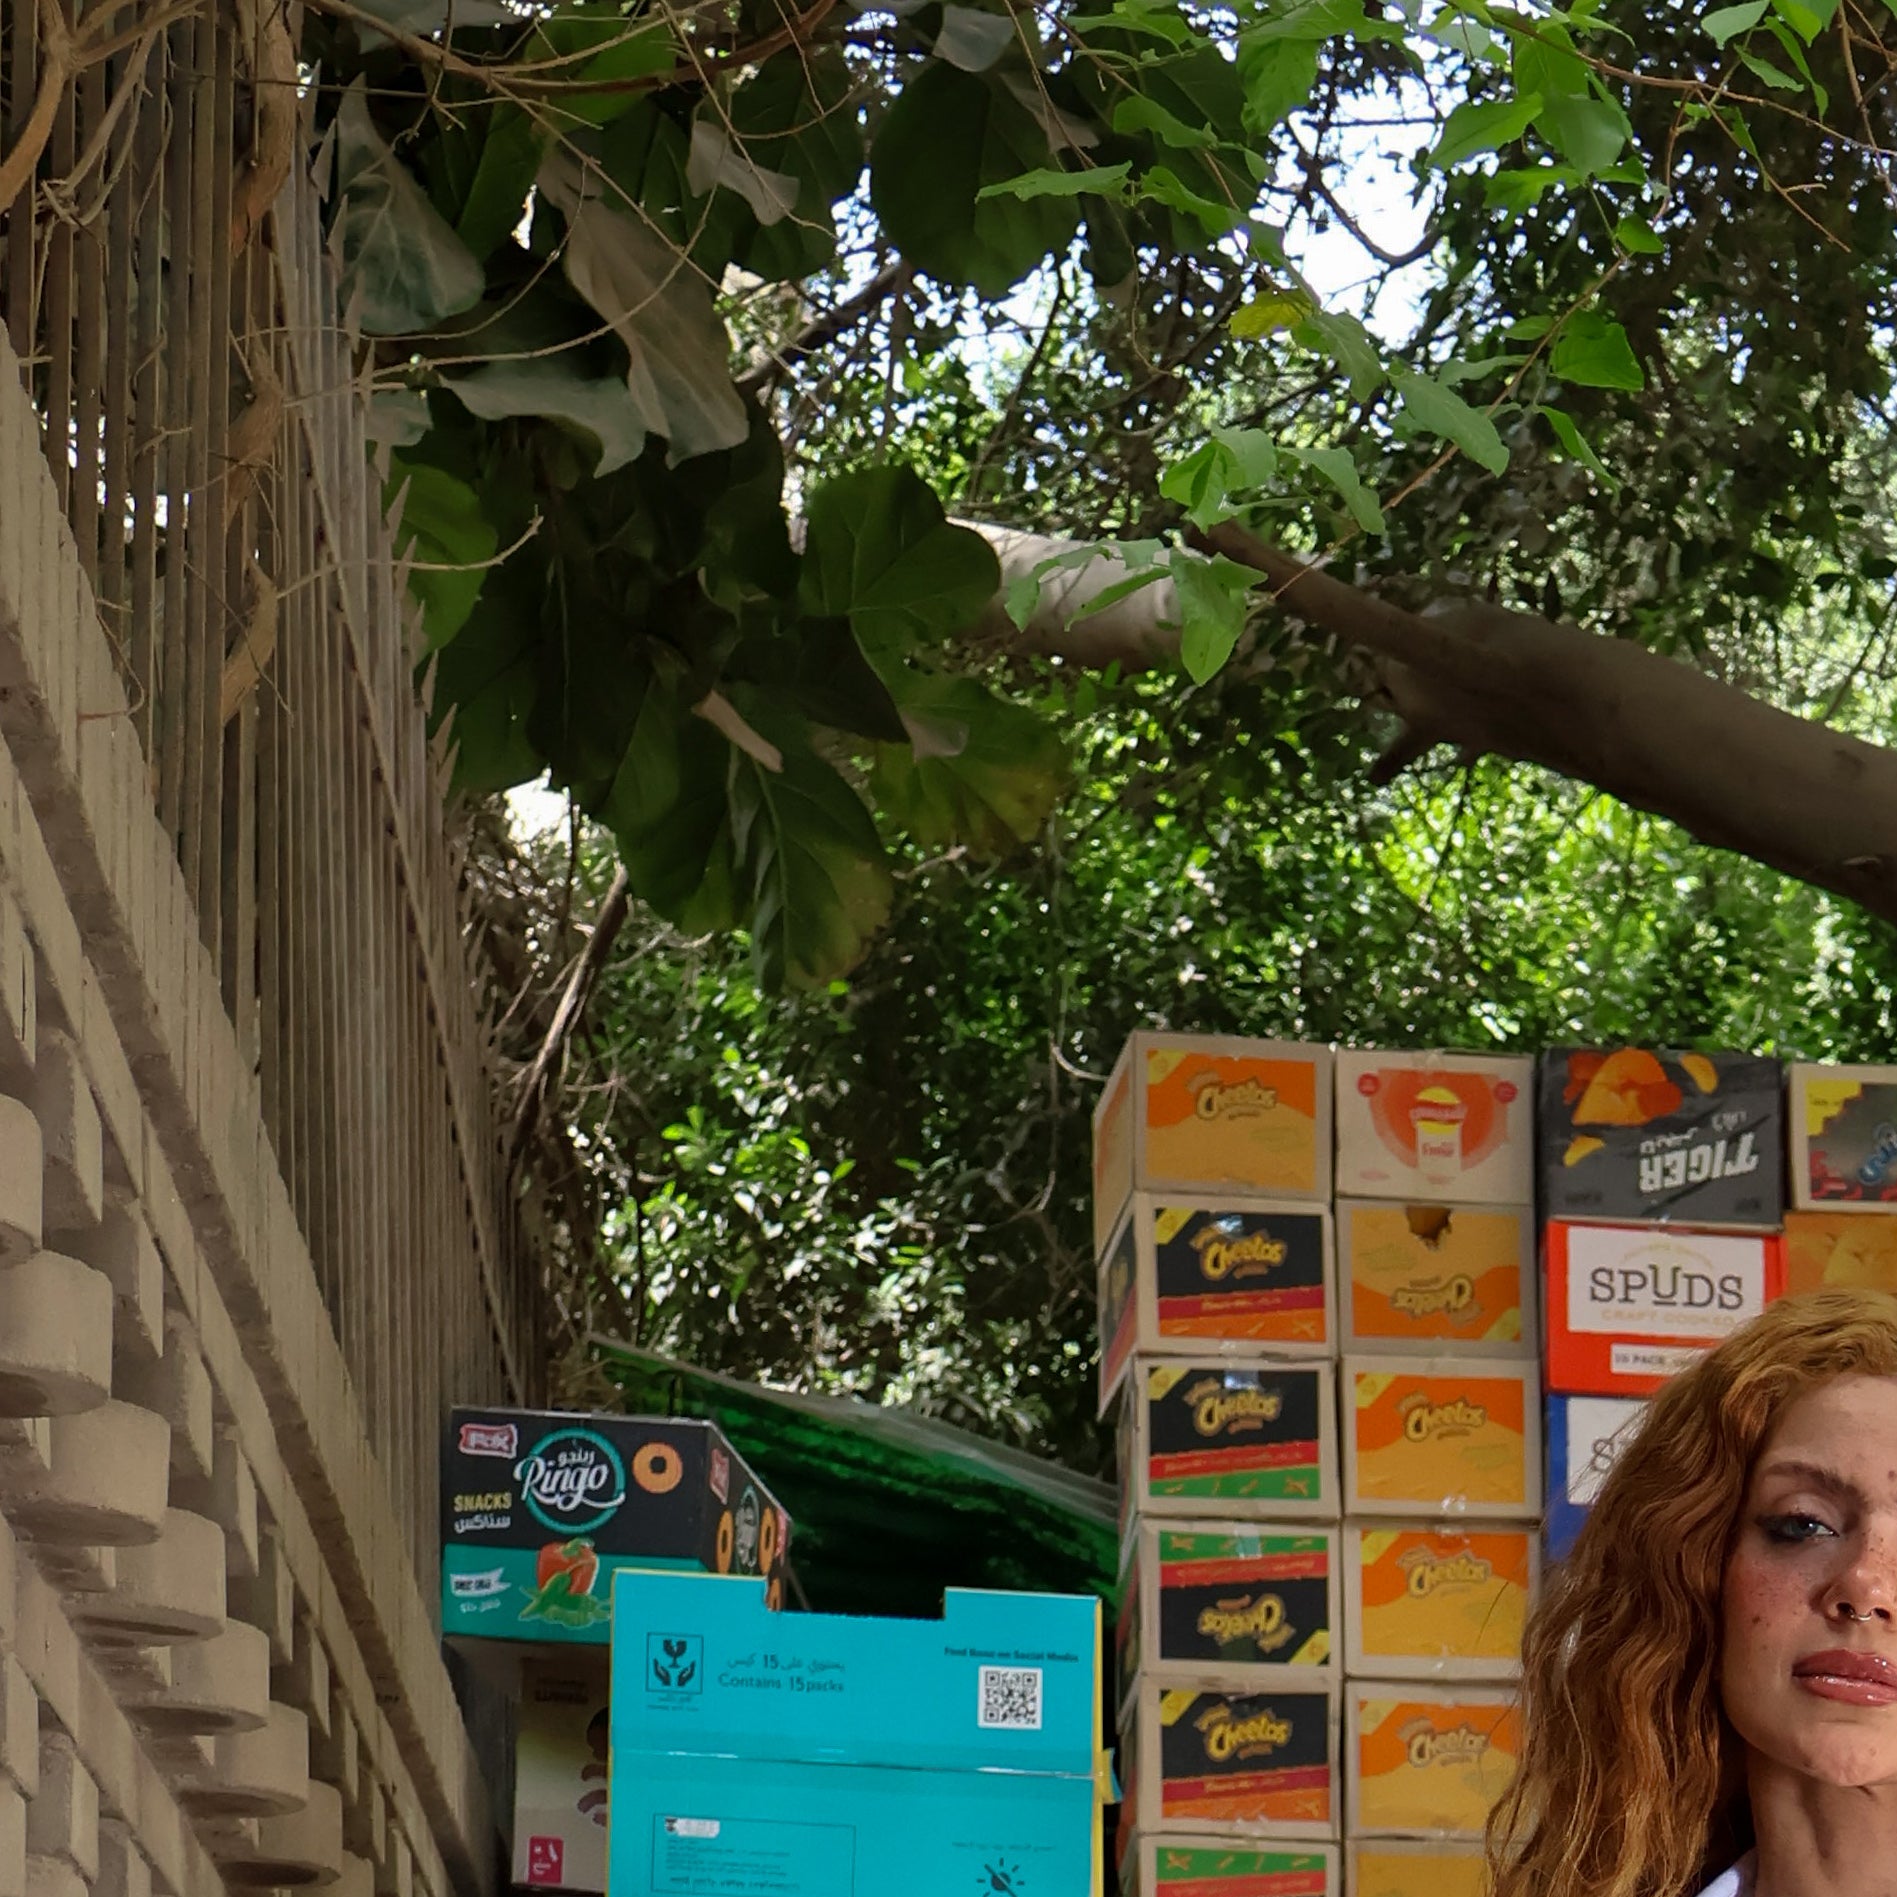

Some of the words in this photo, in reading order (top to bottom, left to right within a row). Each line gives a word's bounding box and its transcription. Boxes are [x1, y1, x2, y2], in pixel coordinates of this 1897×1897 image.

[1639, 1133, 1759, 1193] TIGER
[1201, 1237, 1287, 1280] Cheetos
[1589, 1262, 1744, 1310] SPUDS
[1196, 1391, 1280, 1436] Cheetos
[1404, 1401, 1486, 1442] Cheetos
[454, 1492, 512, 1512] SNACKS
[513, 1456, 626, 1511] Ringo
[718, 1672, 781, 1689] Contains
[789, 1676, 805, 1692] 15
[805, 1679, 845, 1693] packs
[763, 1654, 779, 1669] 15
[1206, 1713, 1292, 1762] Cheetos
